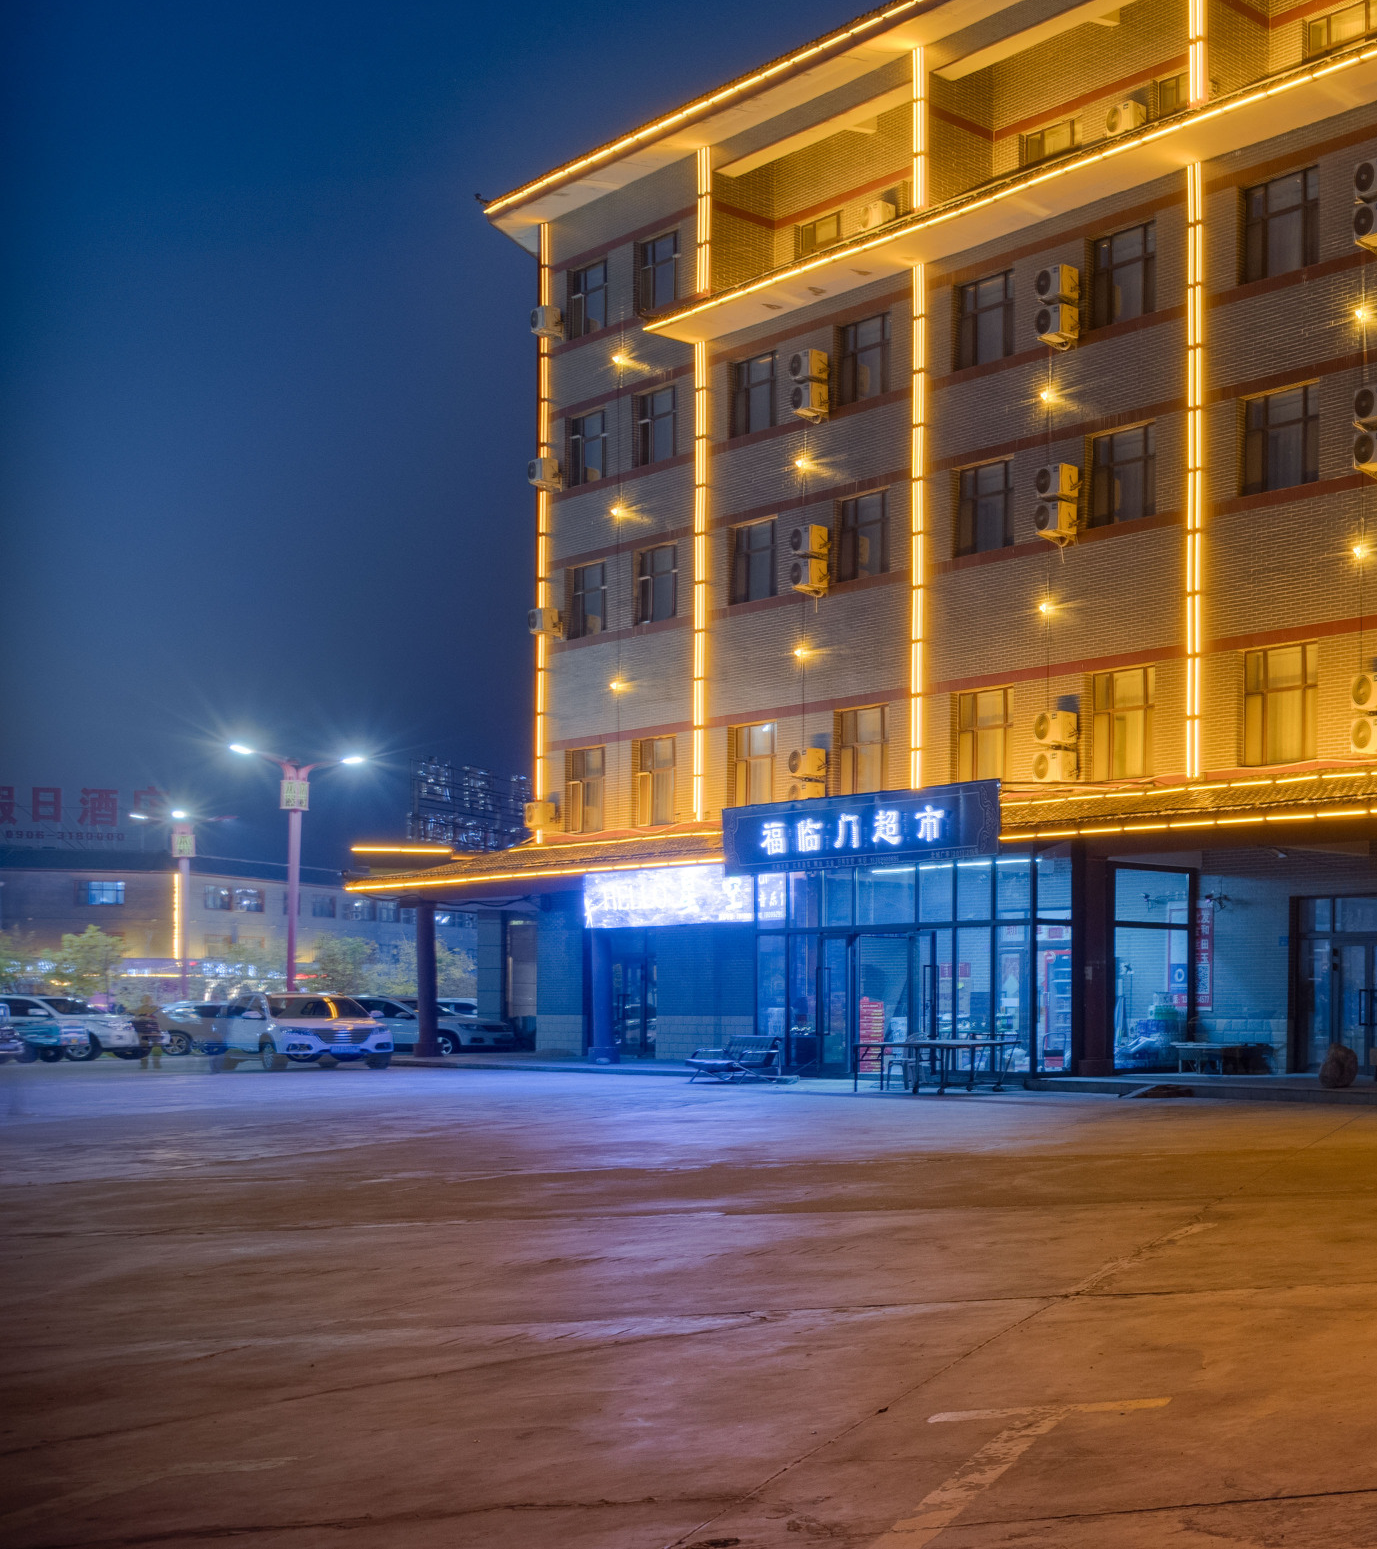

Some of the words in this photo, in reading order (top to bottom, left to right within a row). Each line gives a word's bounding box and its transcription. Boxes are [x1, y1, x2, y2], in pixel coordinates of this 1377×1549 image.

[761, 804, 945, 855] 福临门超市
